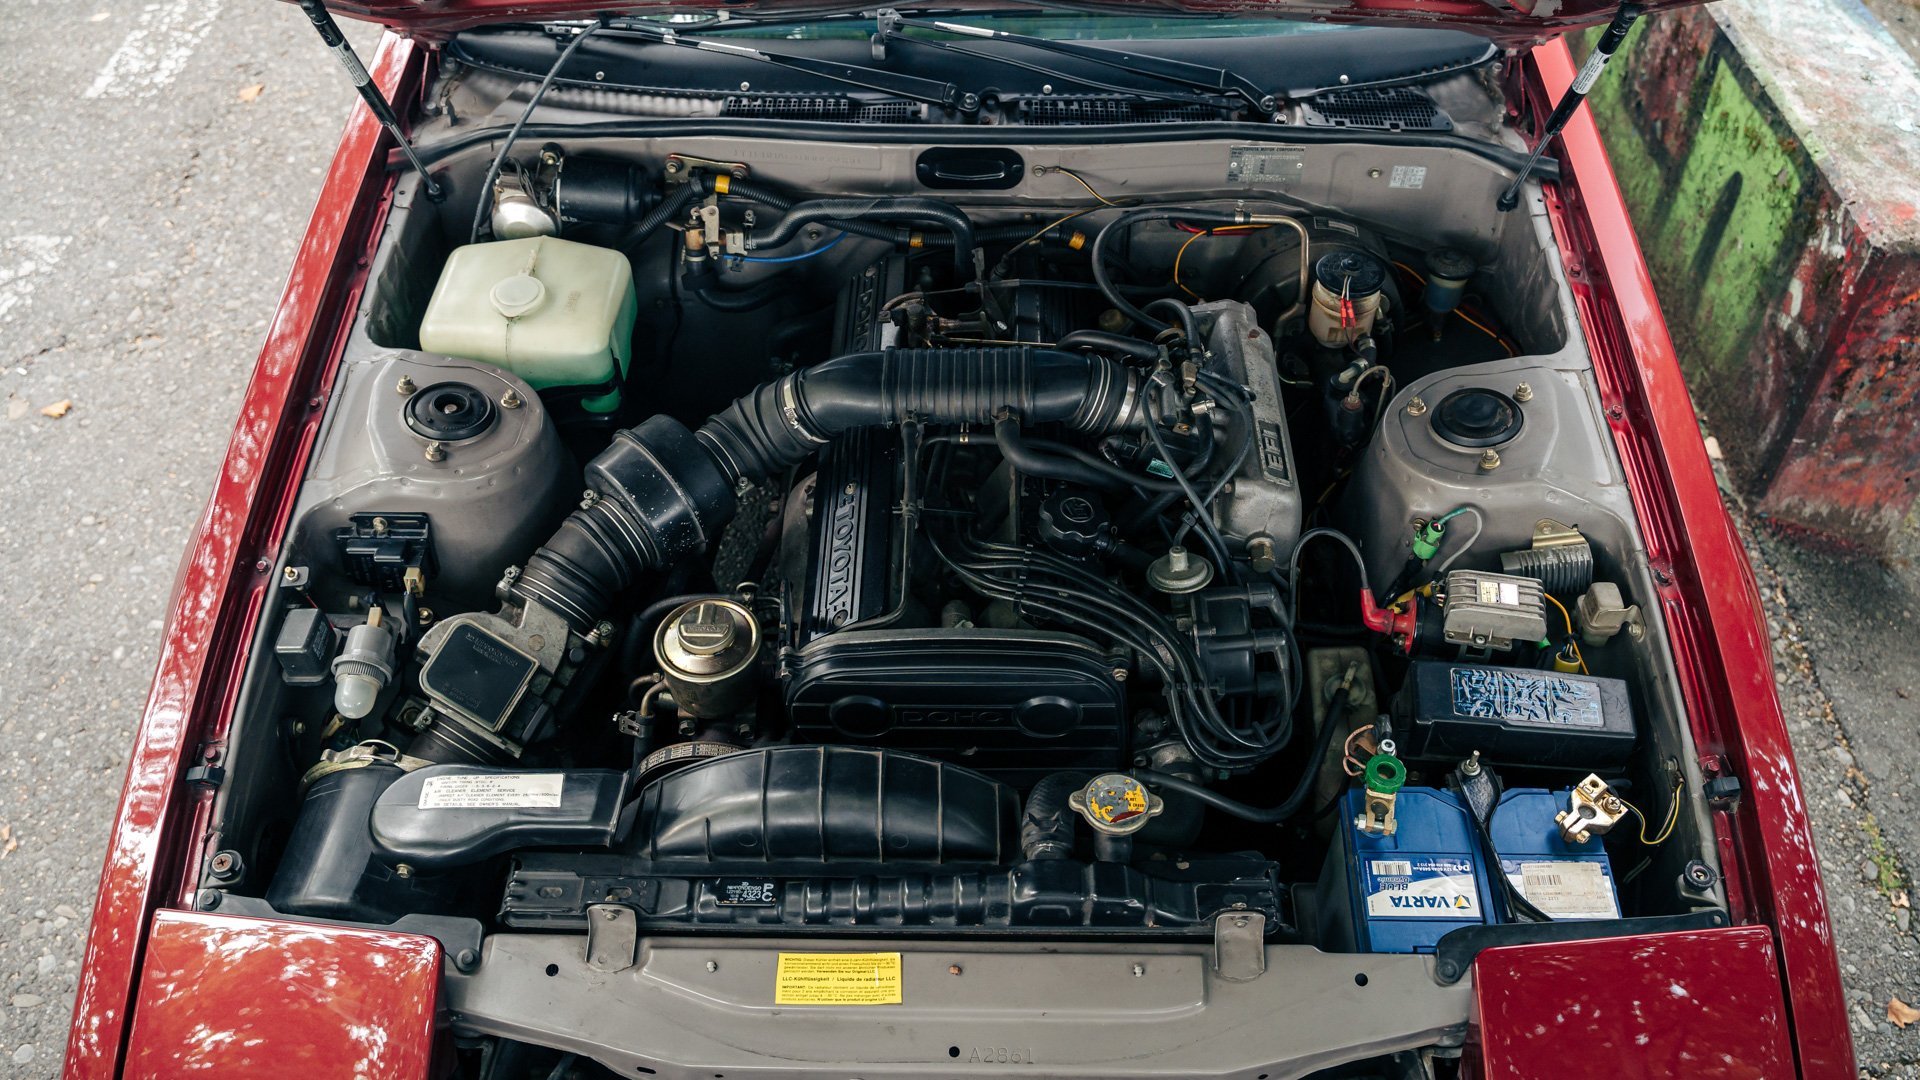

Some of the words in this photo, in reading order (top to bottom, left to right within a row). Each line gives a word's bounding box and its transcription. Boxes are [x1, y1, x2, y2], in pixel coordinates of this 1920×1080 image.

[1262, 430, 1284, 472] EFI
[830, 504, 856, 606] TOYOTA
[902, 711, 1002, 724] DOHC
[763, 883, 774, 892] P
[1379, 883, 1408, 891] BLUE
[762, 892, 773, 902] C
[1389, 896, 1450, 908] VARTA
